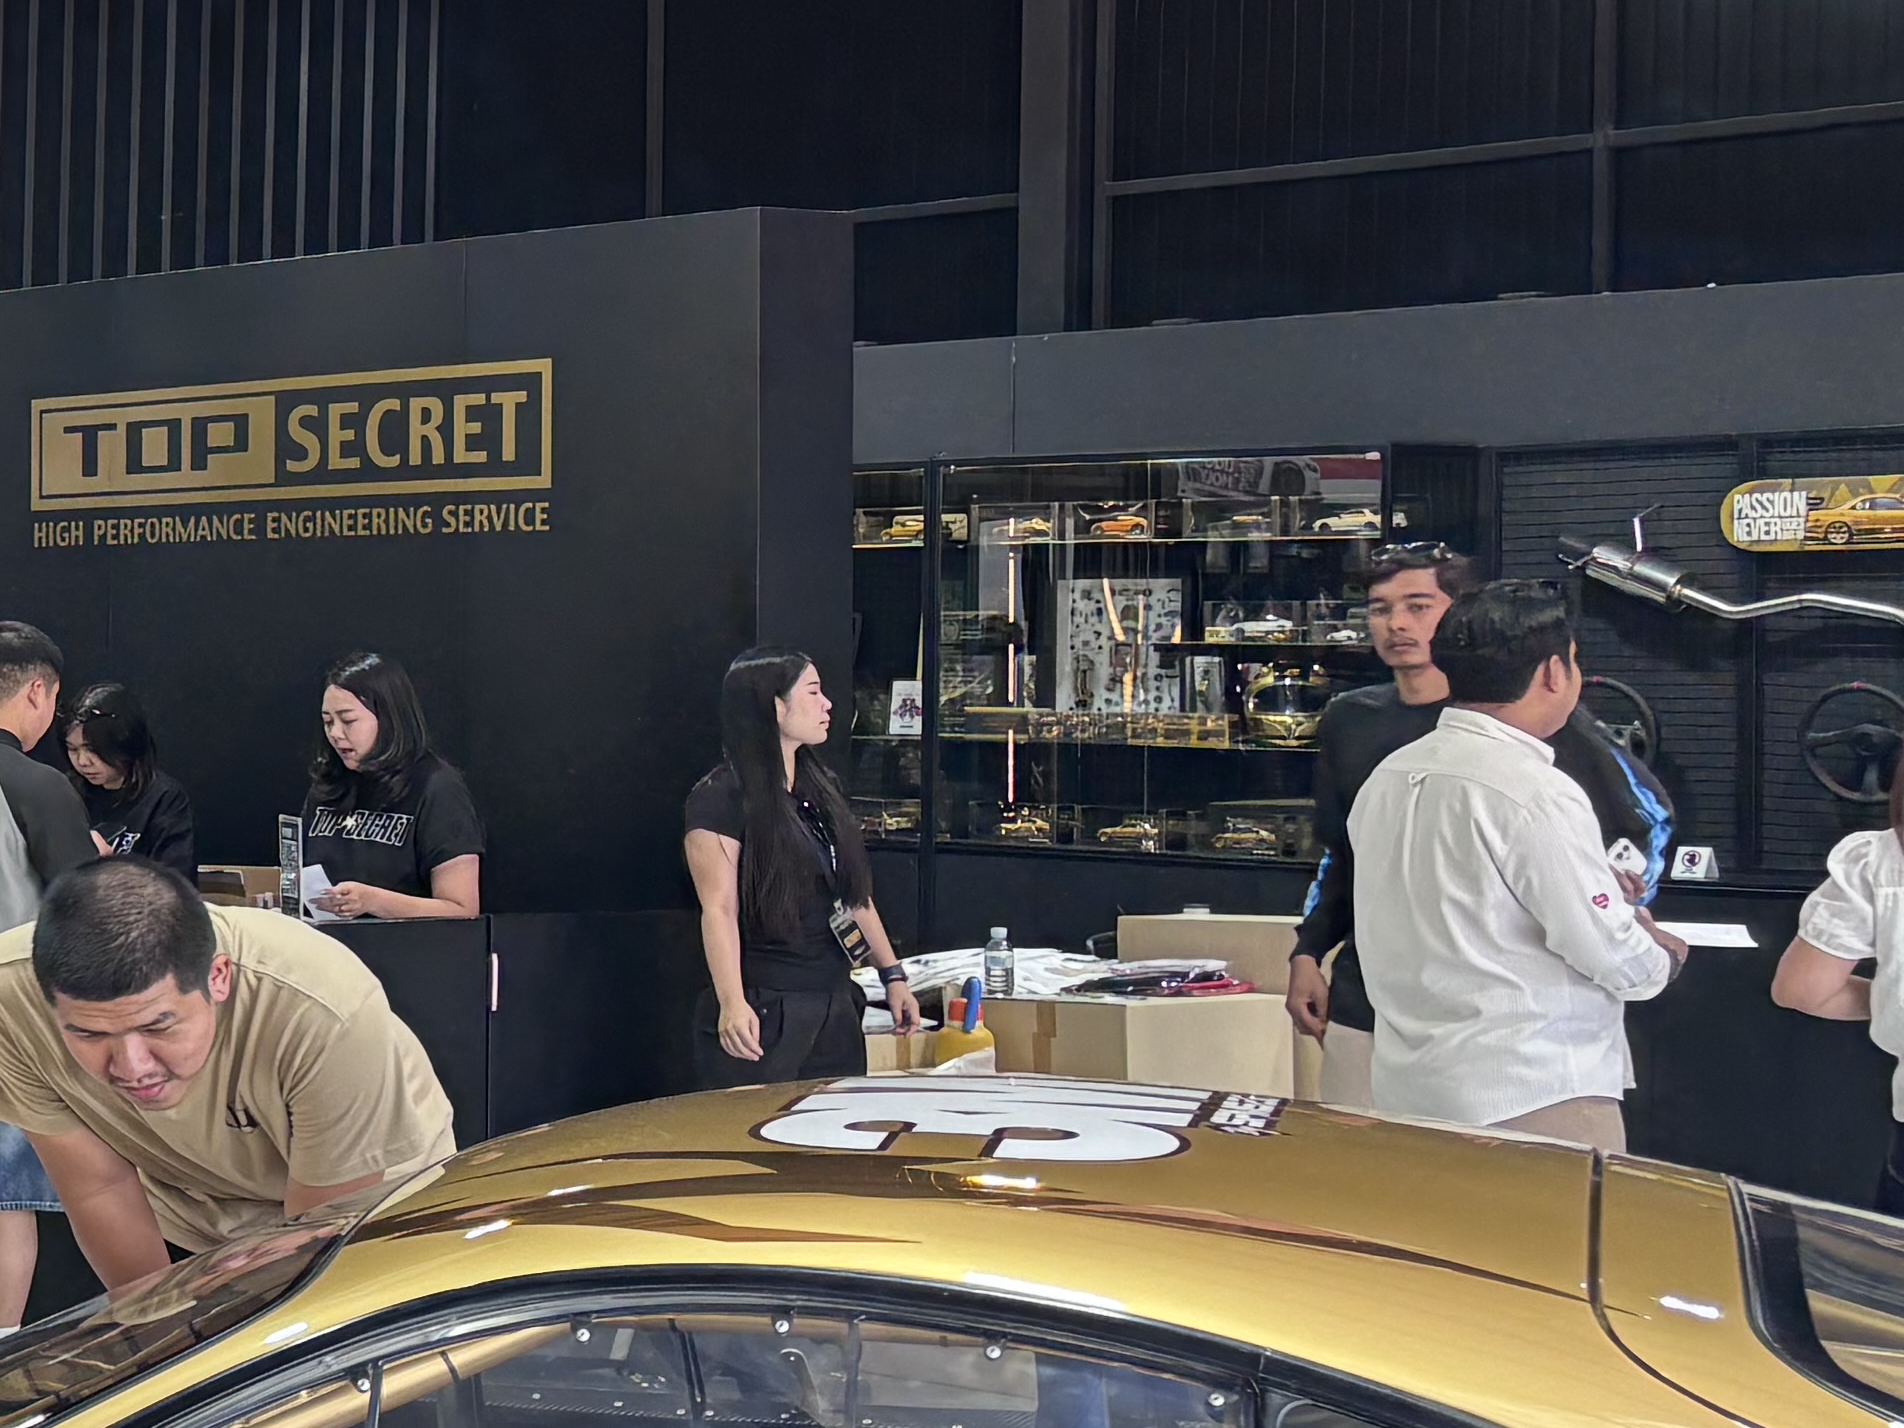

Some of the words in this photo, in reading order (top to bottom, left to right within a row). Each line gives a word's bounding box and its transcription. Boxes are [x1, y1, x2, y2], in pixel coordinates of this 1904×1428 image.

[62, 413, 250, 478] TOP
[285, 391, 528, 473] SECRET
[33, 520, 84, 548] HIGH
[94, 513, 257, 545] PERFORMANCE
[266, 504, 433, 540] ENGINEERING
[441, 502, 550, 534] SERVICE
[1733, 491, 1808, 519] PASSION
